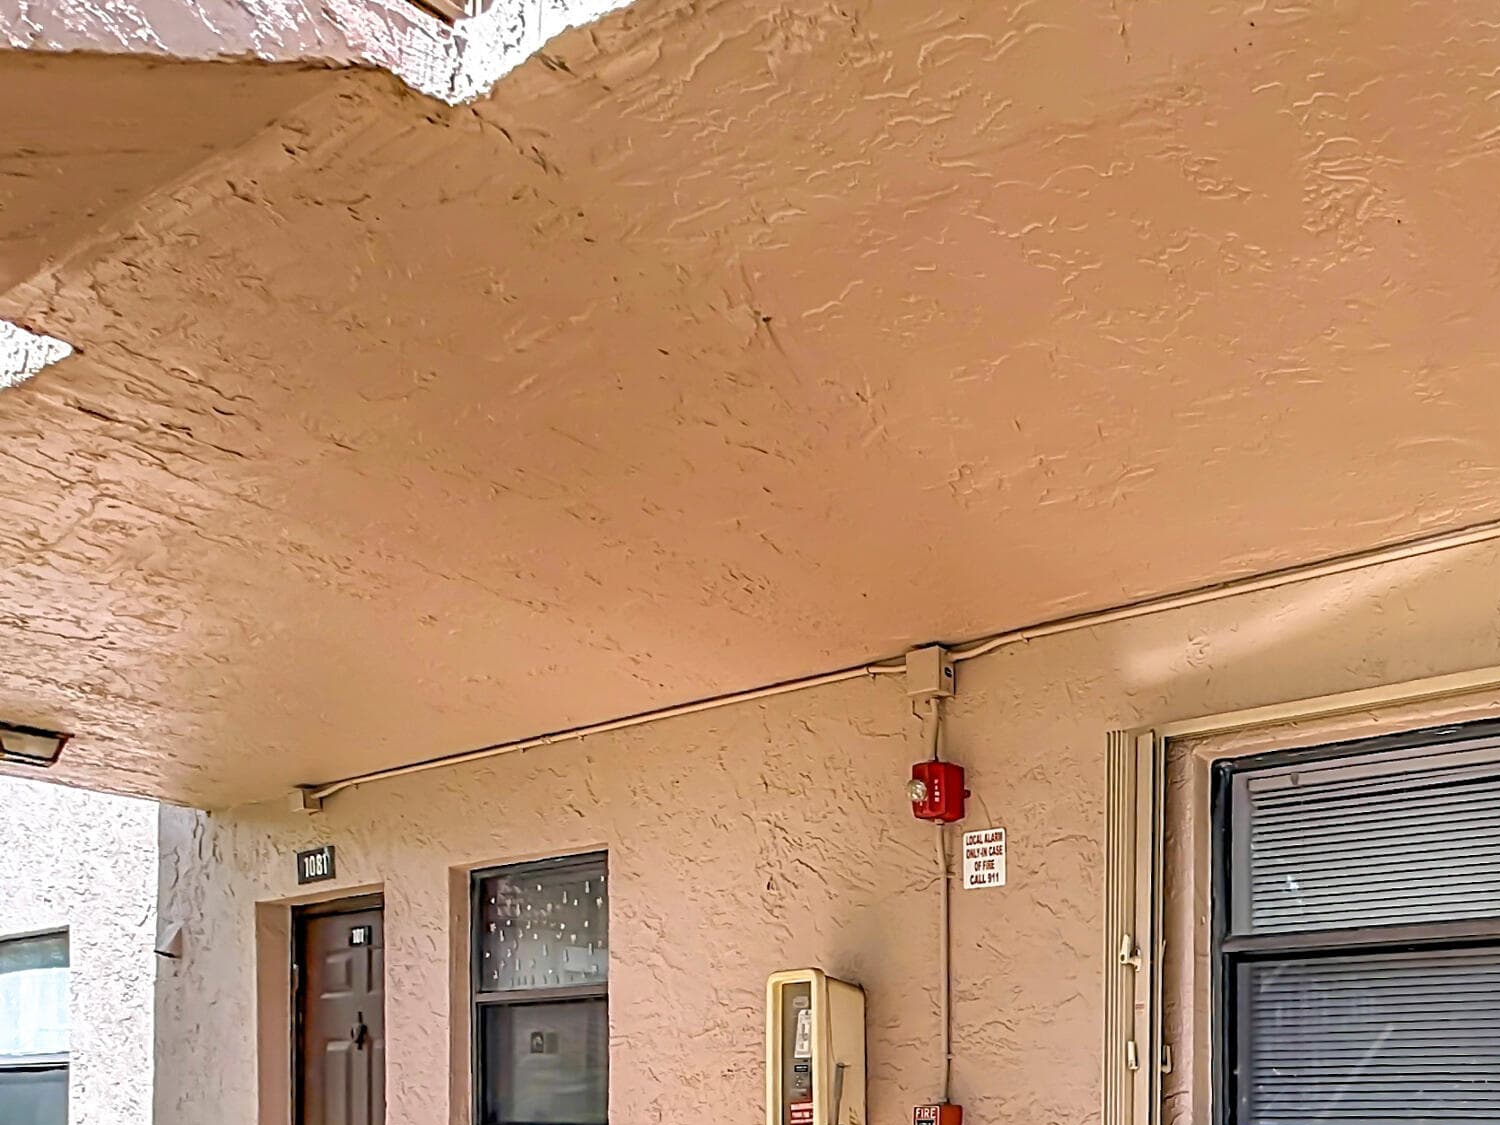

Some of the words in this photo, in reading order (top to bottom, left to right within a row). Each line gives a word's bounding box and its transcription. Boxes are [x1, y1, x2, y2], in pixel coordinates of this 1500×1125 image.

[966, 834, 983, 846] LOCAL
[984, 832, 1003, 843] ALARM
[989, 845, 1003, 856] CASE
[304, 853, 328, 878] 1081
[974, 861, 982, 872] OF
[983, 859, 995, 870] FIRE
[970, 874, 986, 885] CALL
[988, 872, 999, 883] 911
[916, 1108, 936, 1119] FIRE
